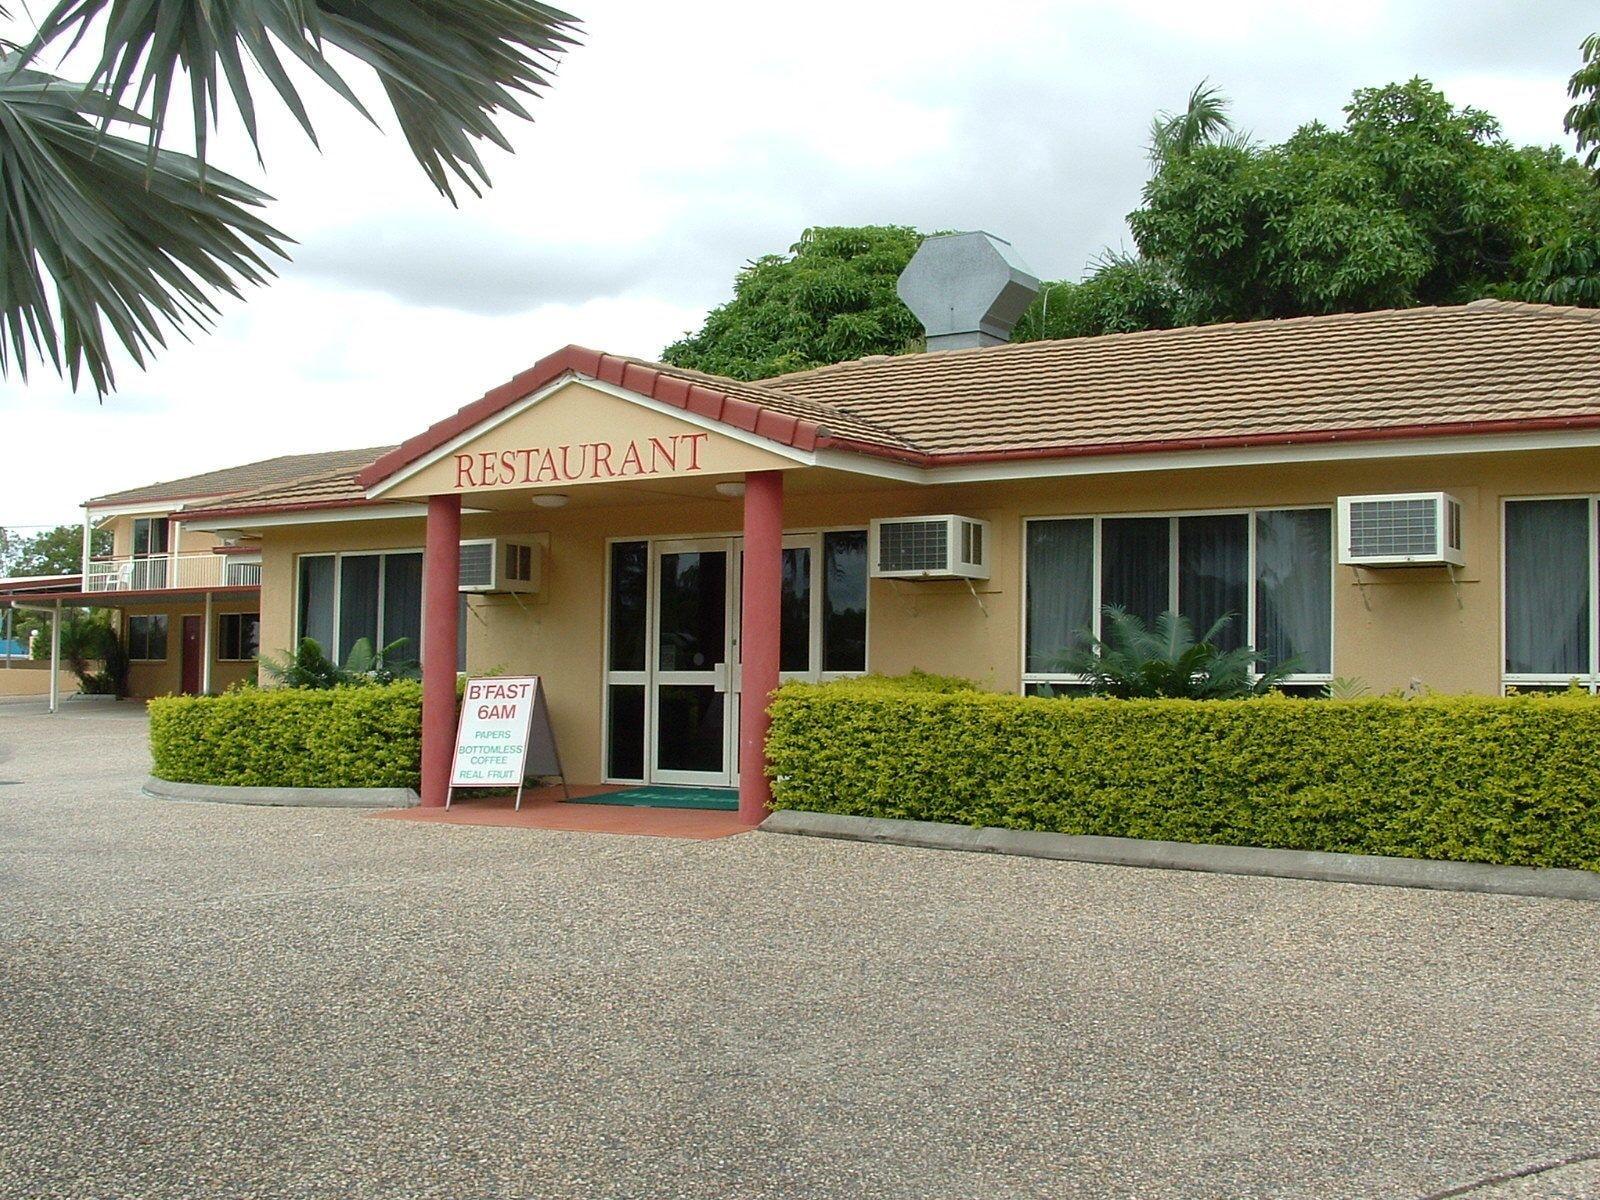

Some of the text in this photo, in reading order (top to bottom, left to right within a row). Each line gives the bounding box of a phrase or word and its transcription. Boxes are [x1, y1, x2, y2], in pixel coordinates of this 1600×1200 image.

[453, 433, 709, 488] RESTAURANT
[469, 684, 530, 699] B'FAST
[477, 704, 516, 719] 6AM
[475, 730, 511, 739] PAPERS
[459, 745, 523, 754] BOTTOMLESS
[471, 756, 508, 765] COFFEE
[460, 770, 514, 779] REAL FRUIT
